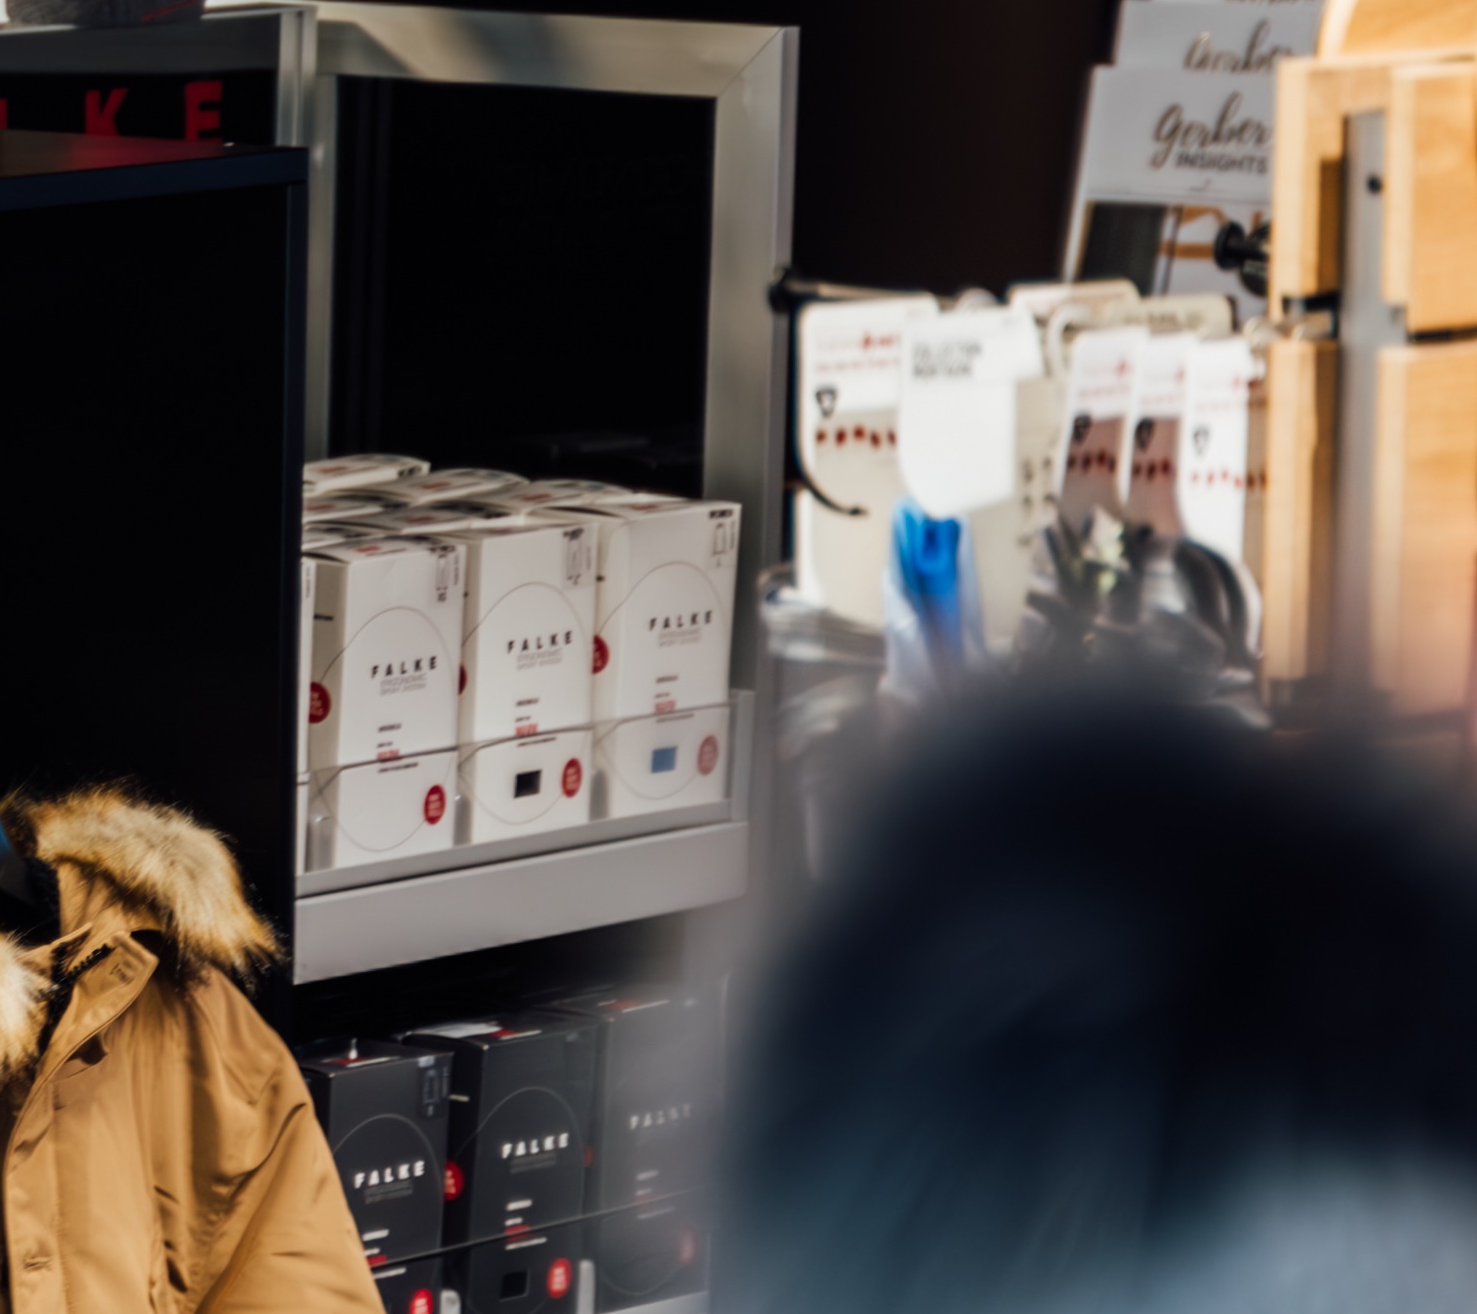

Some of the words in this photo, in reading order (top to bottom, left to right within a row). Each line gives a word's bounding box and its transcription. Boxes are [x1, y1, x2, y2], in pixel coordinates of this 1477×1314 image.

[648, 609, 713, 632] FALKE
[506, 629, 573, 655] FALKE
[370, 655, 438, 679] FALKE
[502, 1132, 570, 1160] FALKE
[354, 1160, 426, 1190] FALKE
